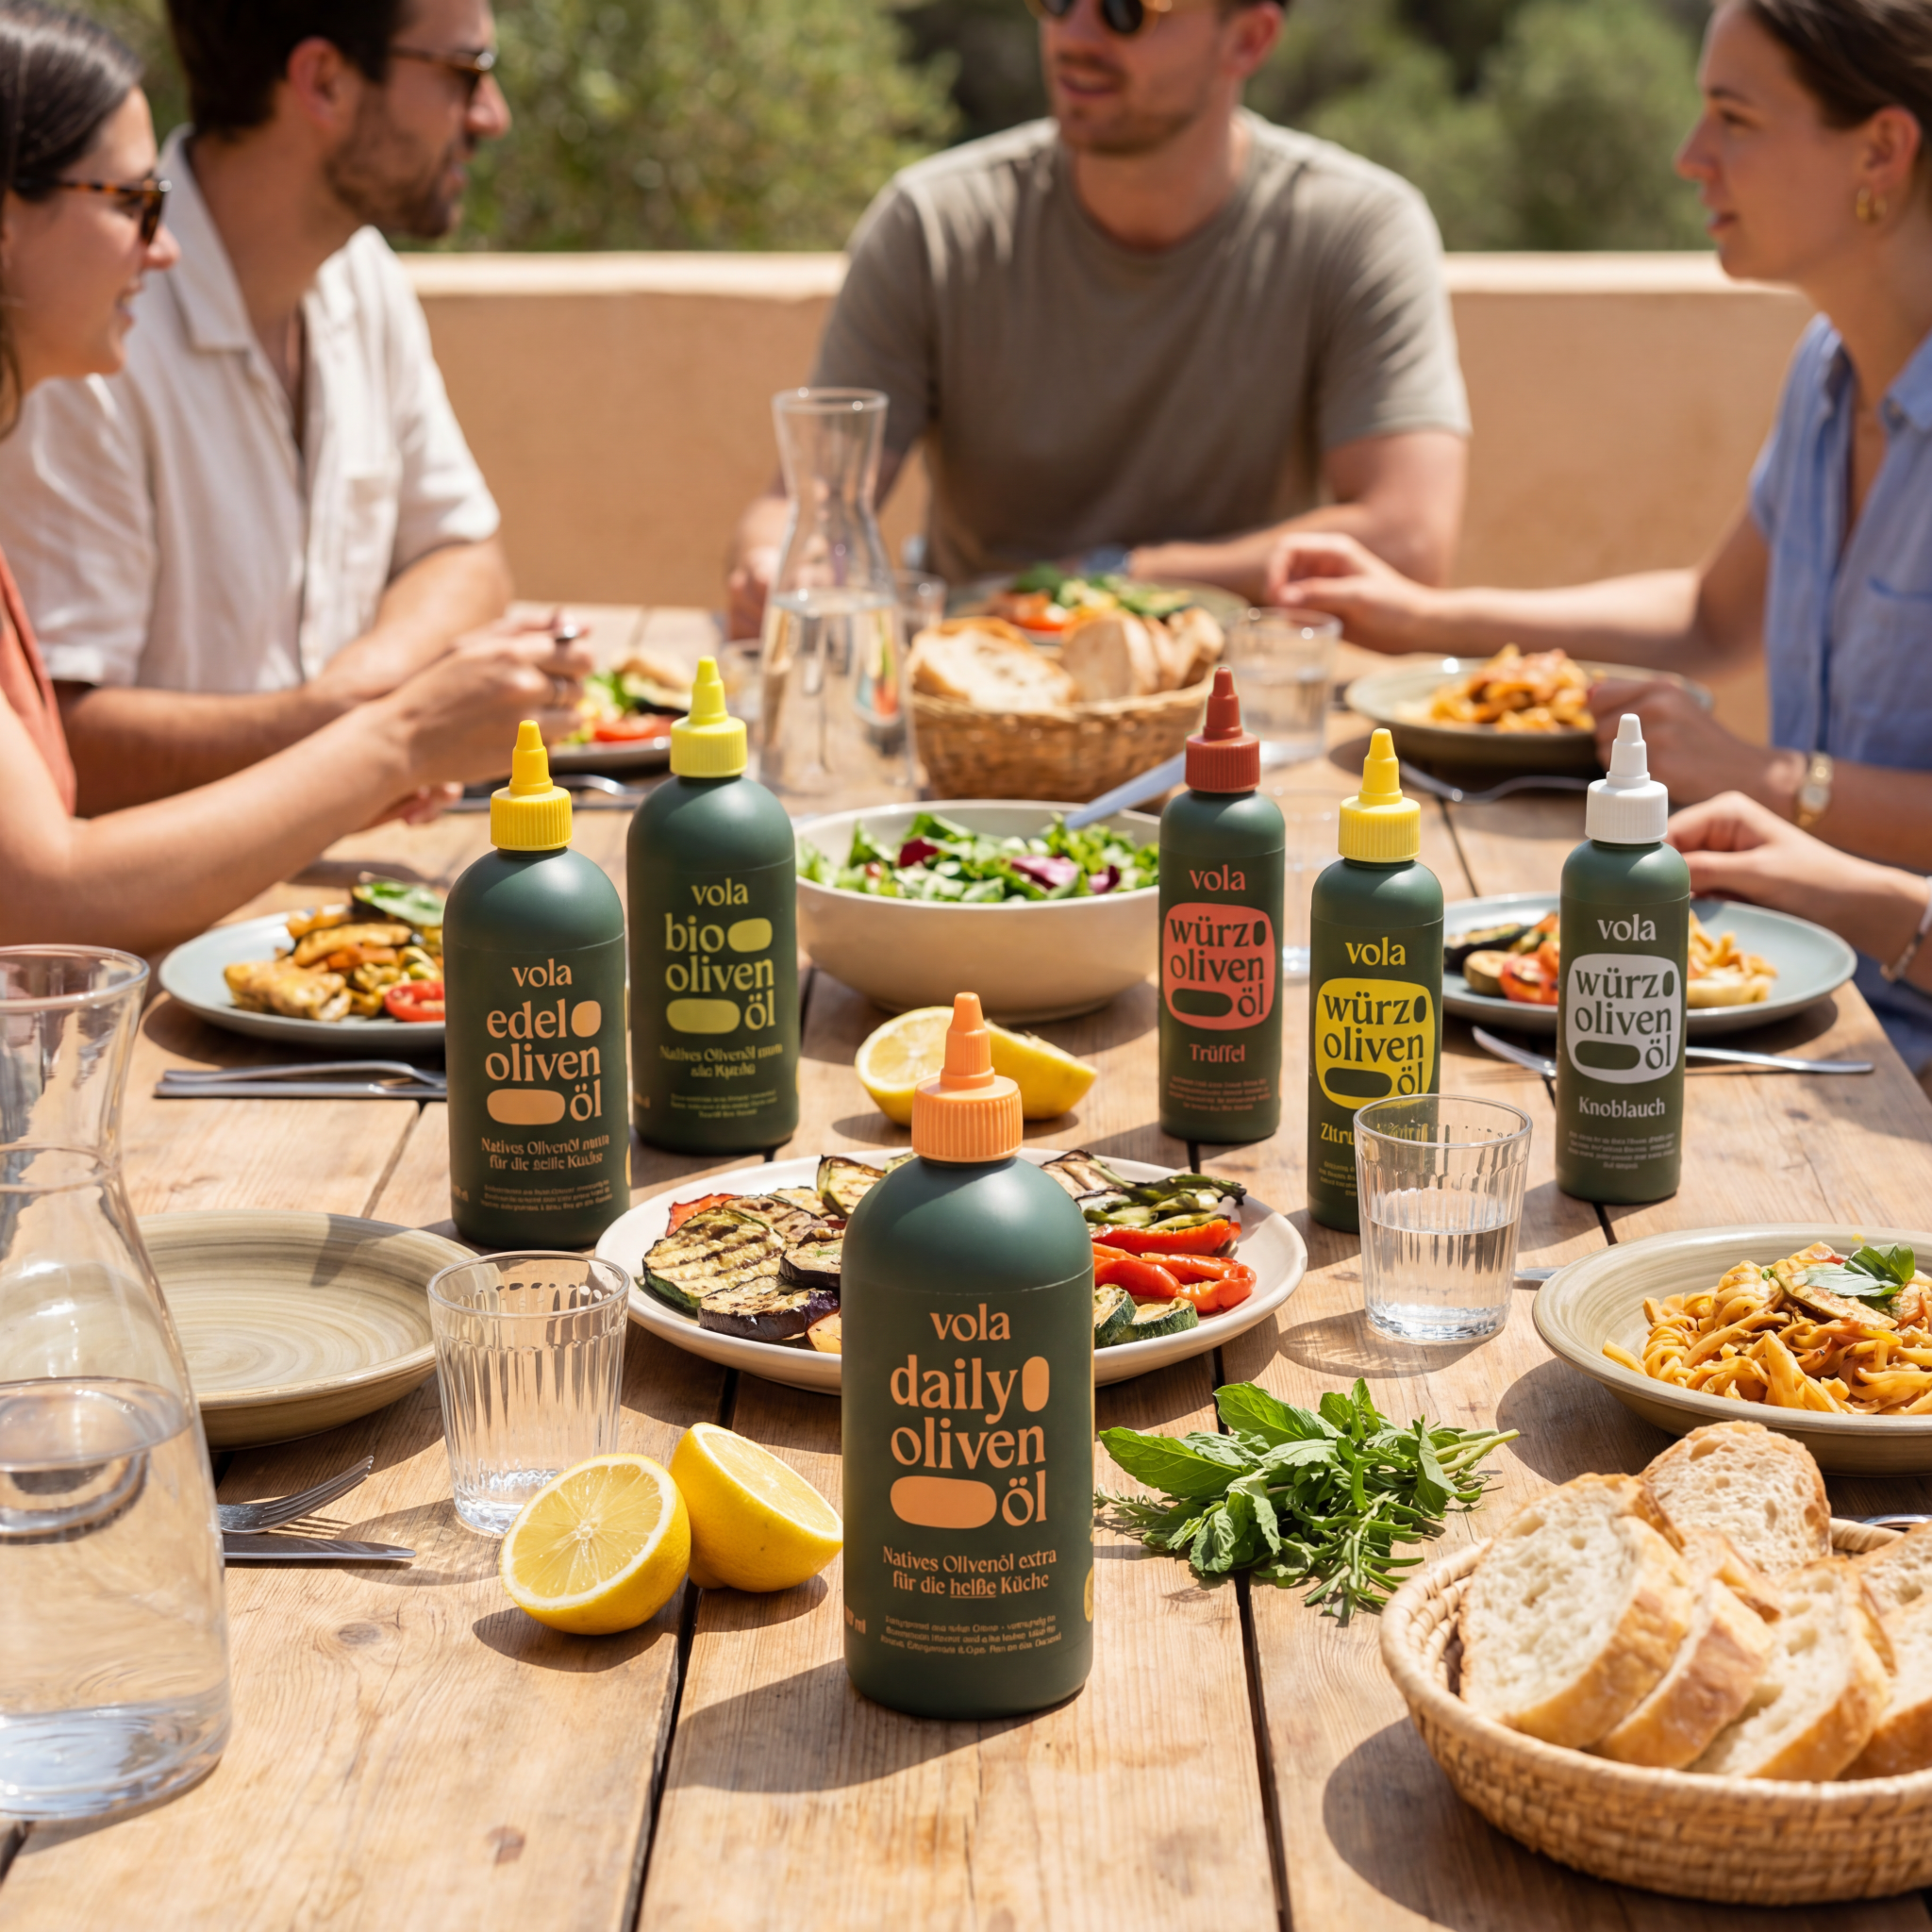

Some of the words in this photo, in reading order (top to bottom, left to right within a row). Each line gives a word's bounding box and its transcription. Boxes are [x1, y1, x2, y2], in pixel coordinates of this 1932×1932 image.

[691, 877, 749, 906] vola
[1189, 864, 1245, 891] vola
[664, 912, 724, 953] bio
[1170, 915, 1250, 947] würz
[1597, 913, 1657, 941] vola
[1170, 948, 1264, 983] oliven
[1345, 937, 1406, 965] vola
[511, 958, 573, 988] vola
[665, 955, 774, 992] oliven
[1574, 967, 1659, 999] würz
[744, 989, 775, 1030] öl
[1238, 983, 1264, 1018] öl
[1323, 991, 1410, 1024] würz
[487, 998, 567, 1039] edel
[1574, 1001, 1672, 1036] oliven
[485, 1042, 601, 1081] oliven
[1189, 1043, 1245, 1063] Trüffel
[1324, 1026, 1424, 1063] oliven
[1645, 1034, 1671, 1070] öl
[1397, 1061, 1423, 1095] öl
[570, 1078, 602, 1122] öl
[1579, 1095, 1666, 1118] Knoblauch
[929, 1303, 1010, 1341] vola
[890, 1354, 1018, 1424] daily
[891, 1416, 1046, 1470] oliven
[1002, 1470, 1047, 1526] öl
[883, 1545, 939, 1573] Natives
[1019, 1550, 1057, 1570] extra
[893, 1570, 916, 1591] für
[920, 1576, 945, 1594] die
[1001, 1573, 1049, 1594] Küche
